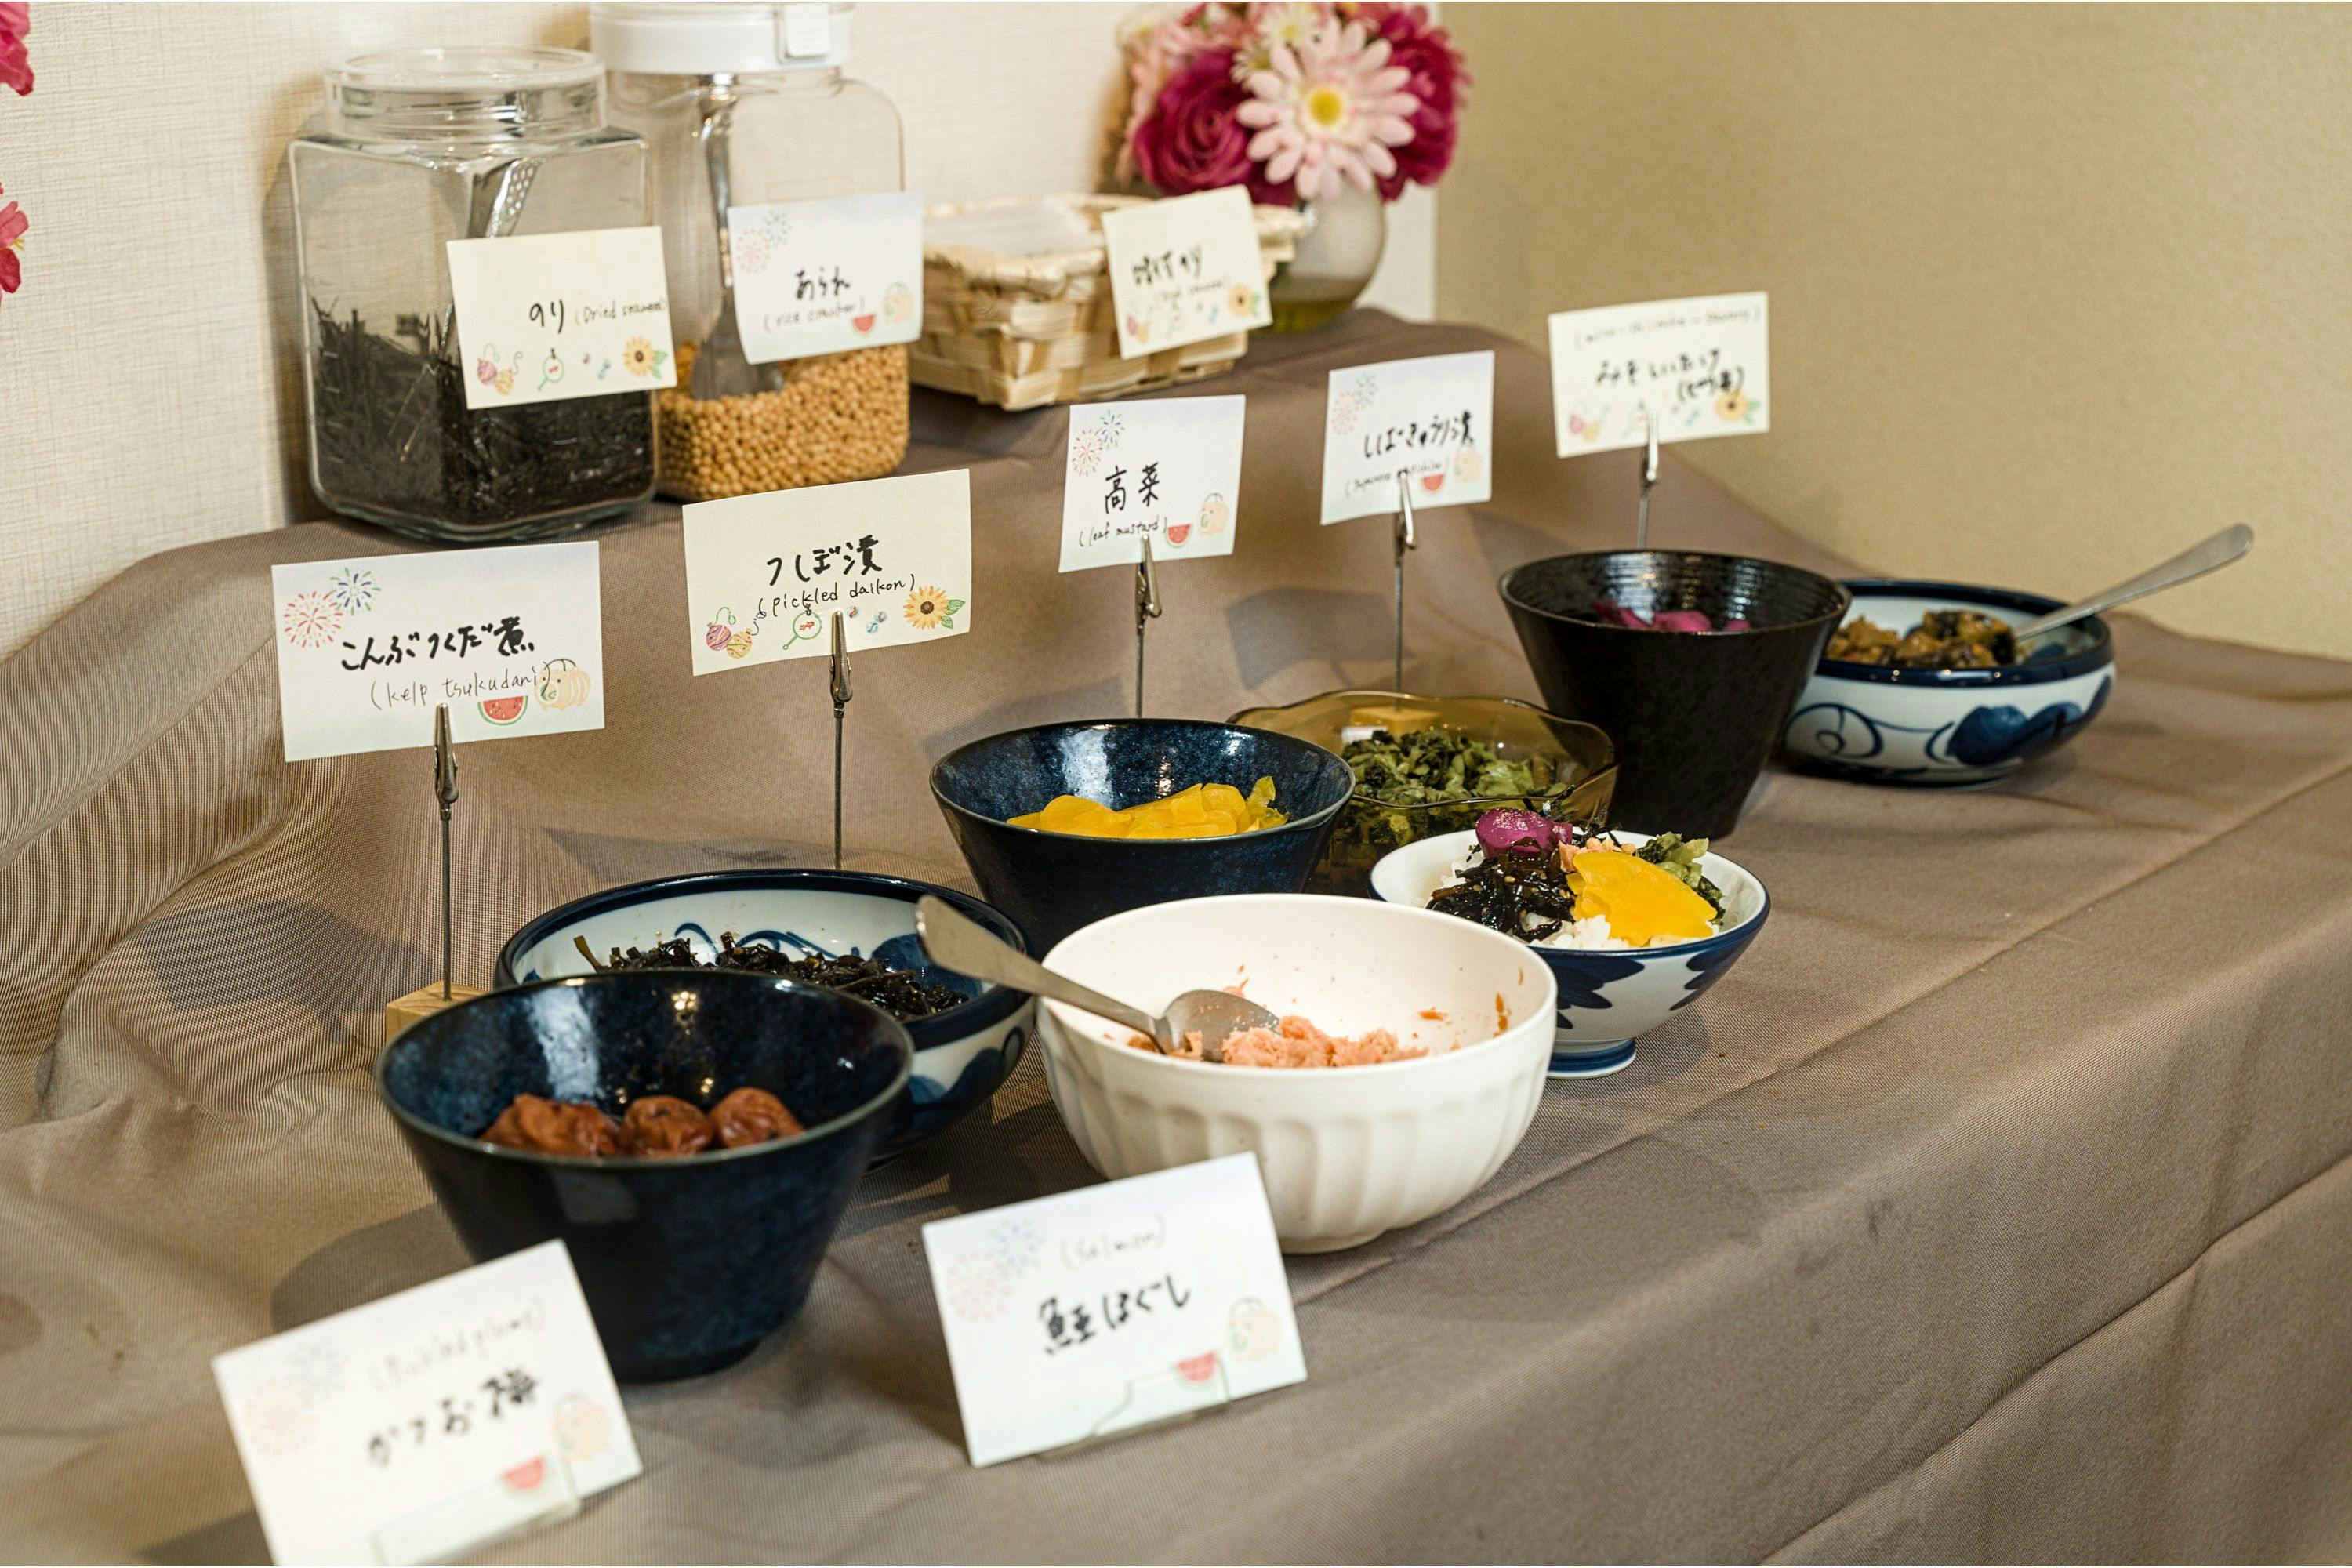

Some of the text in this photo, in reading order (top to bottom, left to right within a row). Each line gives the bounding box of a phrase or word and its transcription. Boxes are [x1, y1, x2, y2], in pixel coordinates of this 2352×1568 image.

[794, 264, 851, 302] あられ
[528, 299, 564, 334] のり
[1105, 461, 1160, 514] 高菜
[767, 534, 883, 586] つぼ漬
[757, 573, 916, 618] (pickled daikon)
[340, 615, 535, 671] こんぶつくだ煮
[370, 660, 552, 711] (kelp tsukudani)
[1038, 1274, 1192, 1356] 鮭ほぐし
